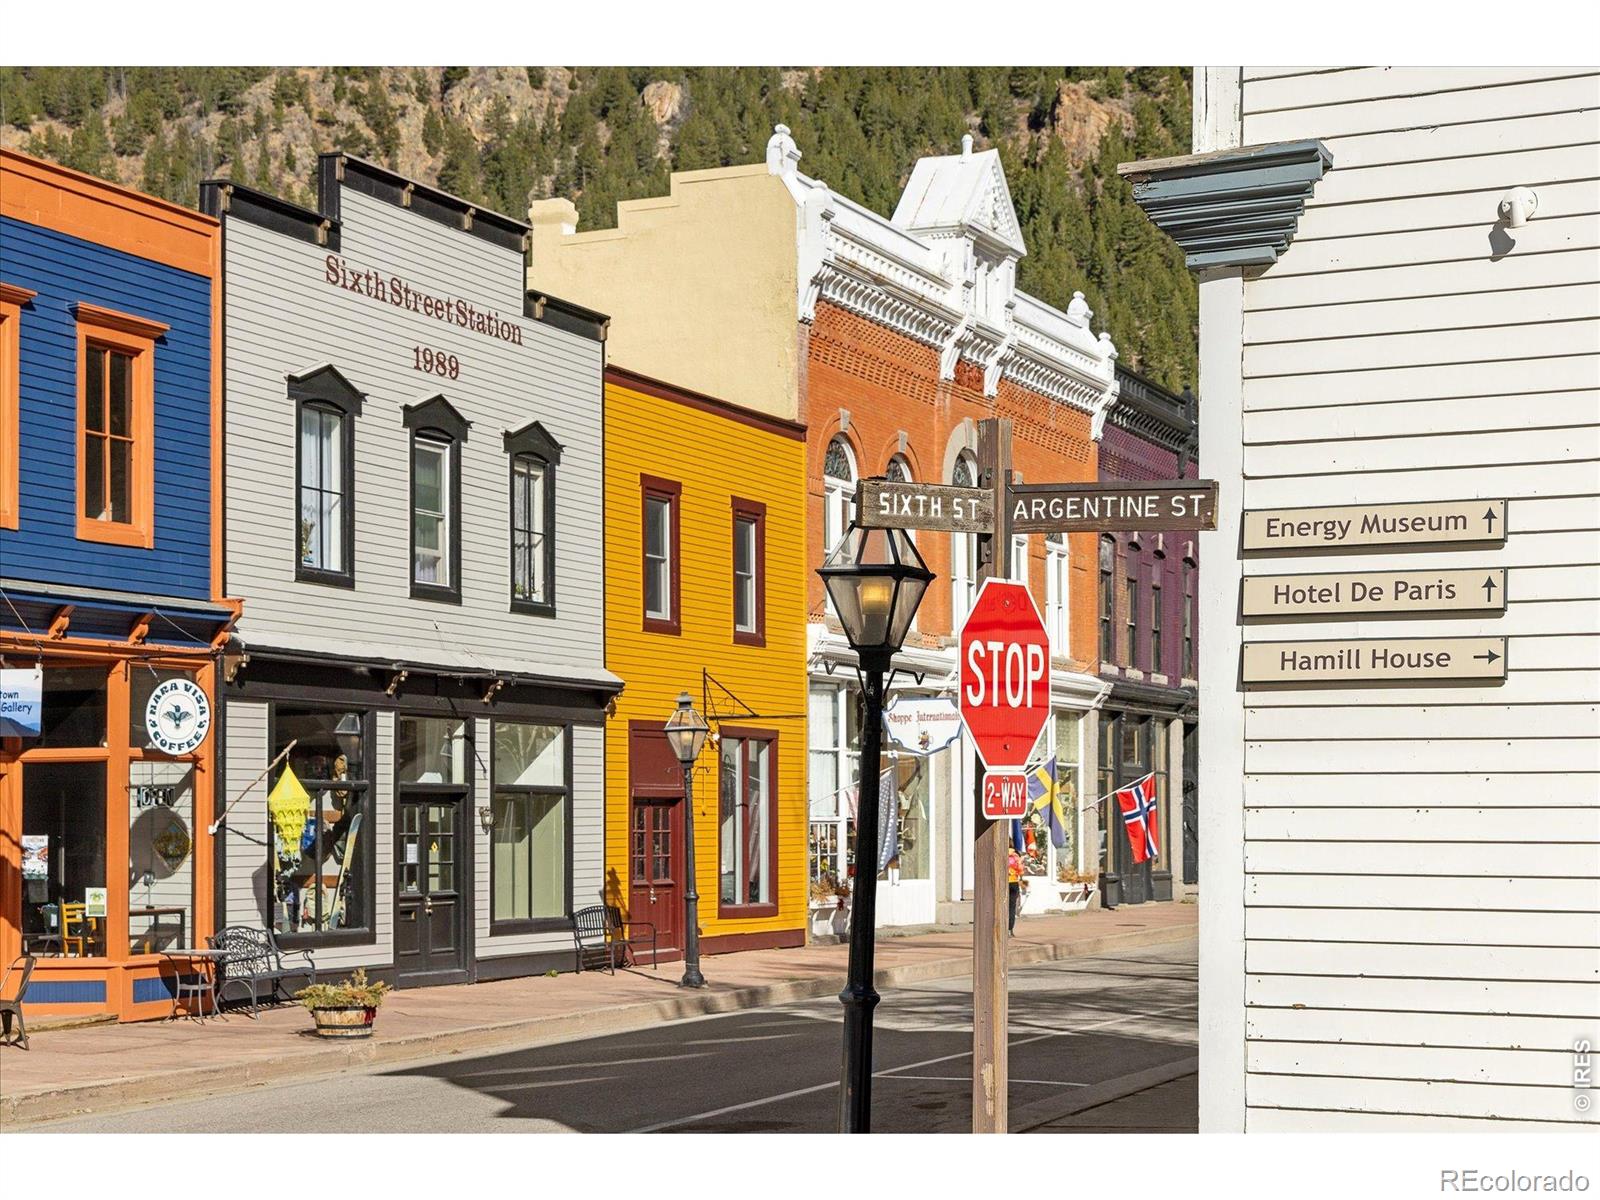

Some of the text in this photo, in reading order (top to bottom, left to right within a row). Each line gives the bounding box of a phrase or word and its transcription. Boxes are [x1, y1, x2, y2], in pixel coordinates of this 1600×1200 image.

[413, 345, 460, 380] 1989
[879, 493, 981, 520] SIXTH ST
[1013, 494, 1213, 520] ARGENTINE ST.
[1266, 513, 1467, 540] Energy Museum
[1274, 579, 1457, 605] Hotel De Paris
[1280, 648, 1451, 671] Hamill House
[966, 639, 1045, 709] STOP
[1, 702, 33, 715] Gallery
[184, 683, 207, 716] VISA
[153, 730, 202, 751] COFFEE
[987, 782, 1024, 809] 2-WAY
